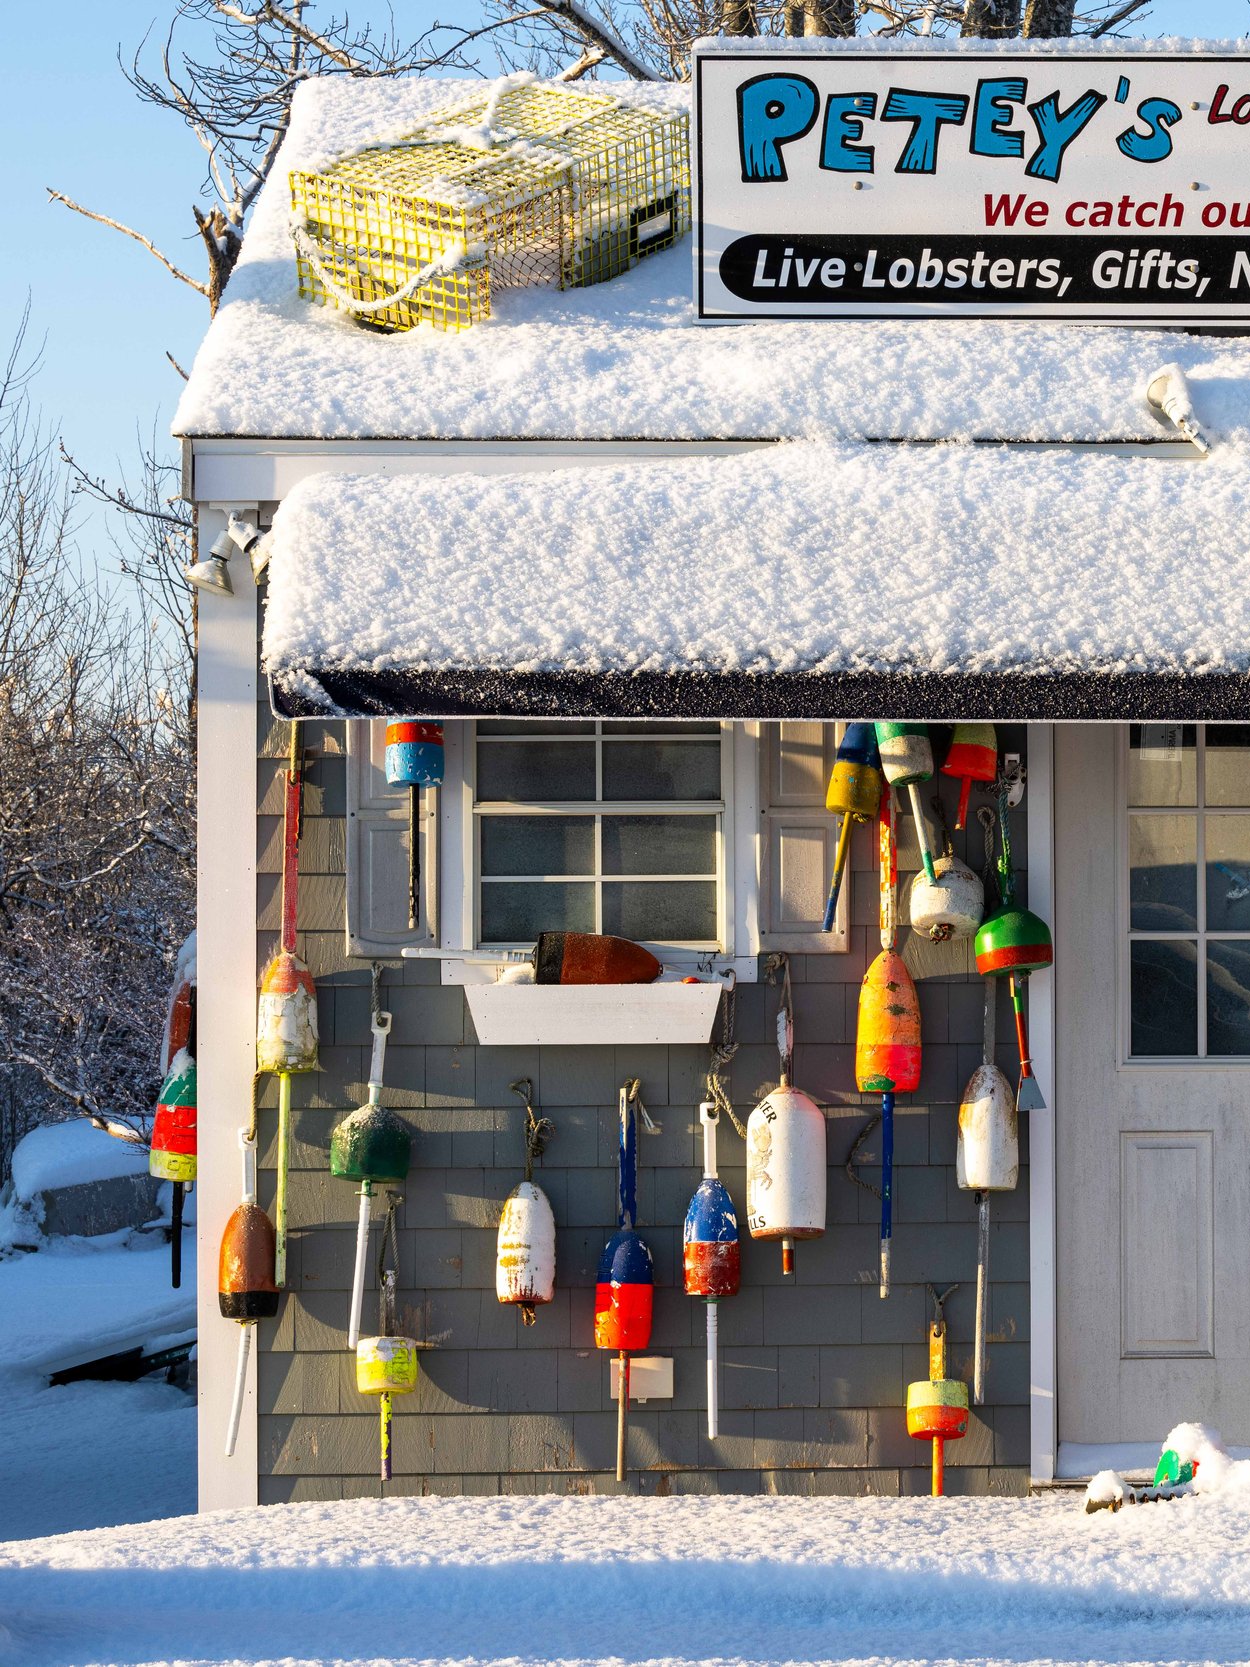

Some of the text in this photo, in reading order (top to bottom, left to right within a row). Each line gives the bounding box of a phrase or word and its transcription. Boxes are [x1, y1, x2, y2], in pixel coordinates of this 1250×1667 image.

[736, 72, 1182, 183] PETEY'S
[983, 193, 1049, 227] We
[1064, 193, 1184, 228] catch
[752, 248, 846, 288] Live
[861, 248, 1072, 297] Lobsters,
[1091, 248, 1211, 298] Gifts,
